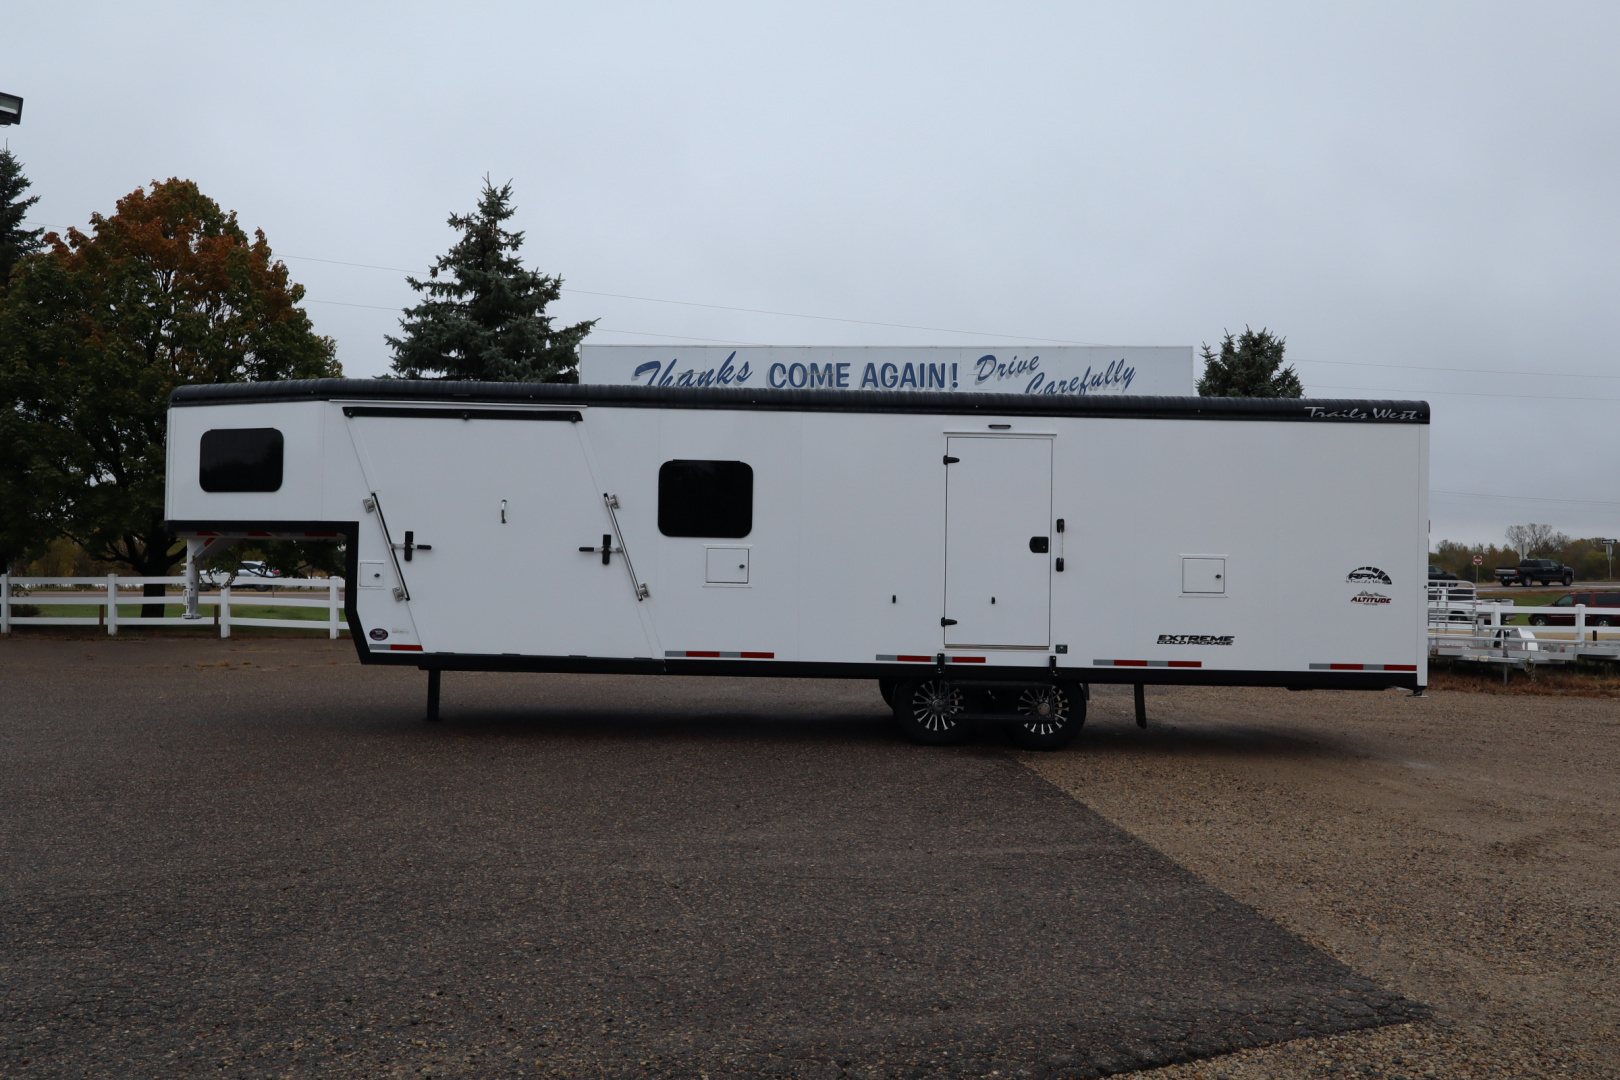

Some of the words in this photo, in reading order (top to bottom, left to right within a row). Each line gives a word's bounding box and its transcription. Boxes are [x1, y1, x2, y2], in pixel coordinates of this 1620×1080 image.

[634, 350, 753, 387] Thanks
[768, 362, 851, 389] COME
[861, 362, 959, 389] AGAIN!
[976, 354, 1040, 382] Drive
[1025, 358, 1136, 395] Carefully
[1304, 406, 1368, 419] Trails
[1372, 407, 1418, 420] West
[1350, 596, 1392, 604] ALTITUDE
[1158, 634, 1235, 642] EXTREME
